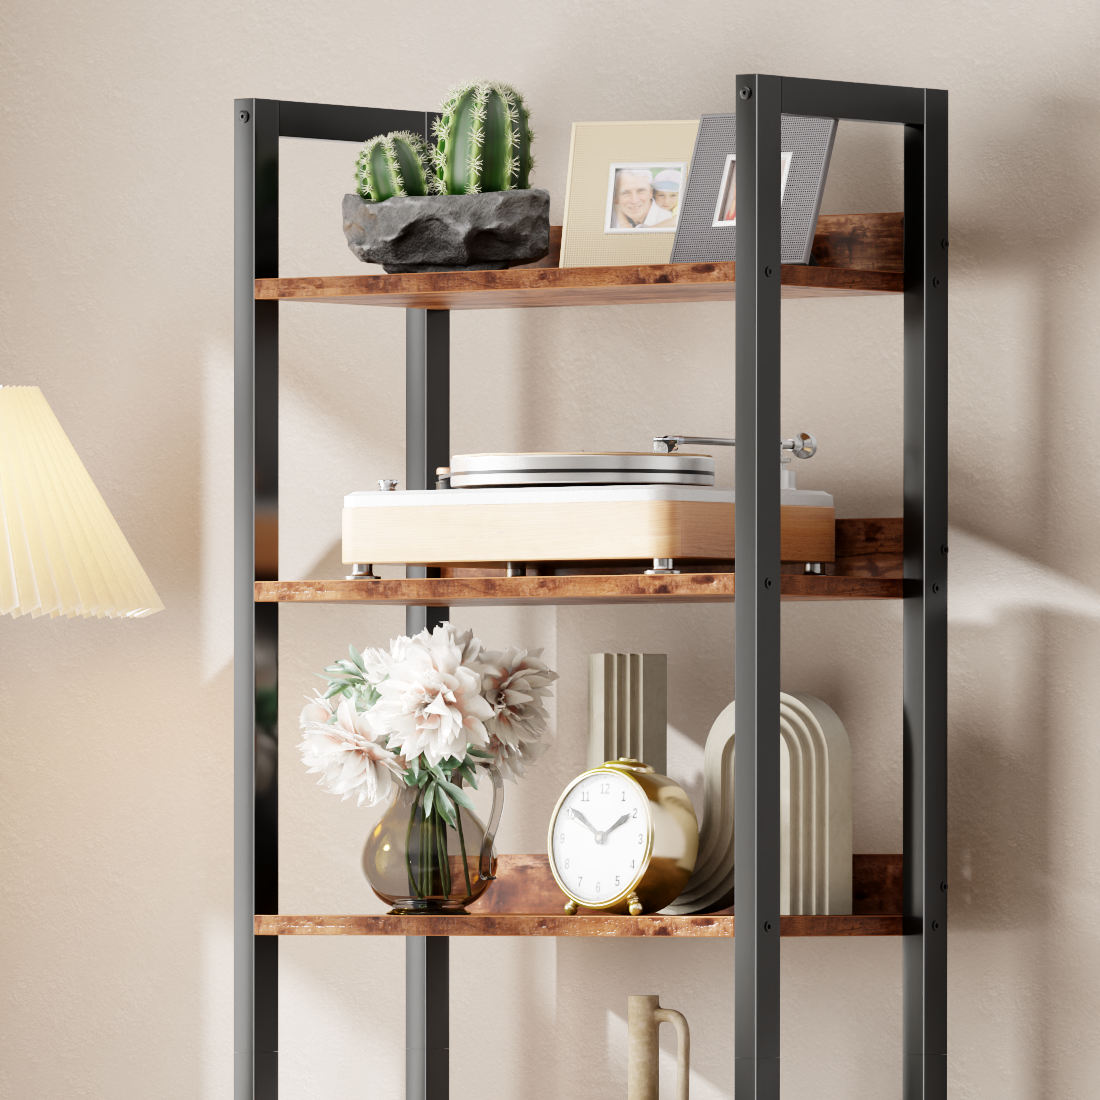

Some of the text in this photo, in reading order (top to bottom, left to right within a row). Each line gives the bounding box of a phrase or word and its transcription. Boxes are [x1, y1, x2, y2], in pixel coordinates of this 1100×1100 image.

[600, 783, 610, 794] 12
[581, 791, 590, 802] 11
[621, 791, 626, 802] 1
[632, 808, 638, 819] 2
[638, 833, 644, 845] 3
[564, 858, 570, 869] 8
[630, 859, 635, 870] 4
[577, 876, 583, 887] 7
[614, 875, 620, 887] 5
[595, 882, 601, 893] 6
